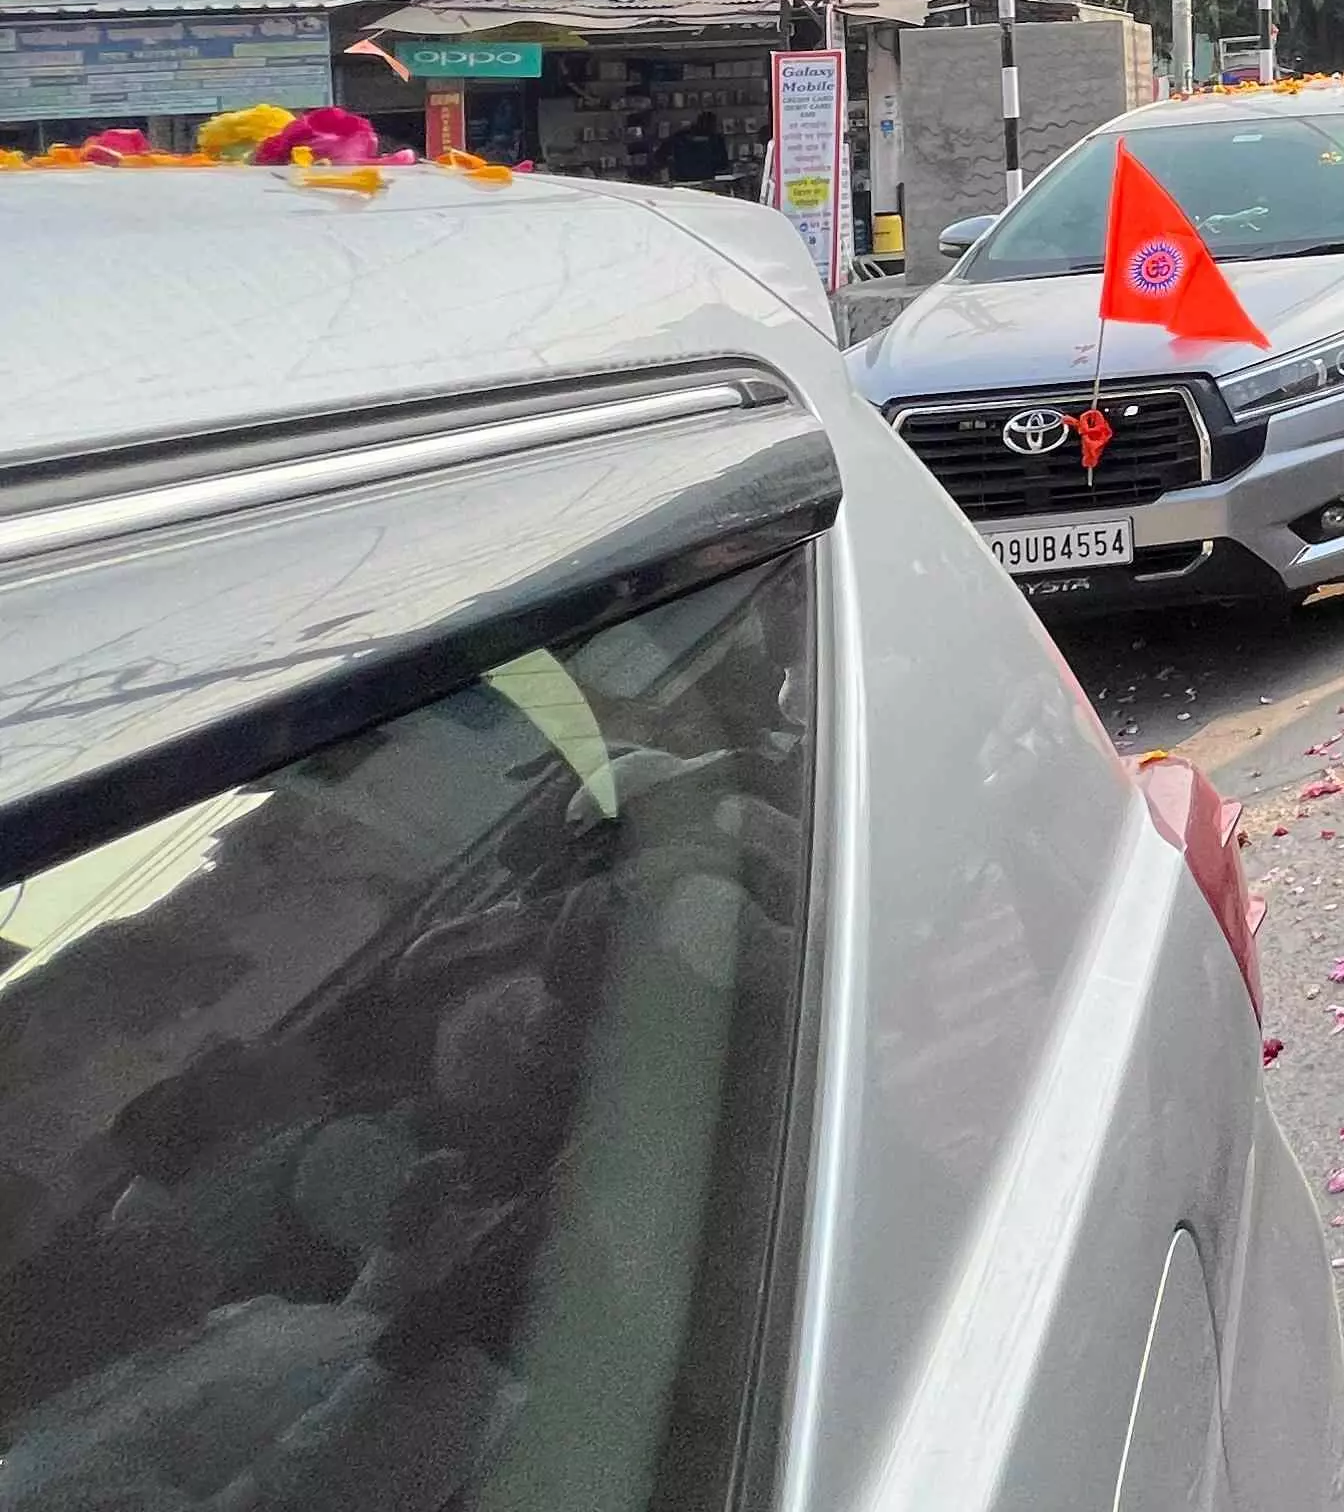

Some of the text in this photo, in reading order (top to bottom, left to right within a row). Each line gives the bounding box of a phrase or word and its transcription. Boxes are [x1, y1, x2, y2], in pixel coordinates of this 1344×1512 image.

[413, 50, 522, 67] oppo
[782, 66, 834, 79] Galaxy
[782, 81, 835, 92] Mobile
